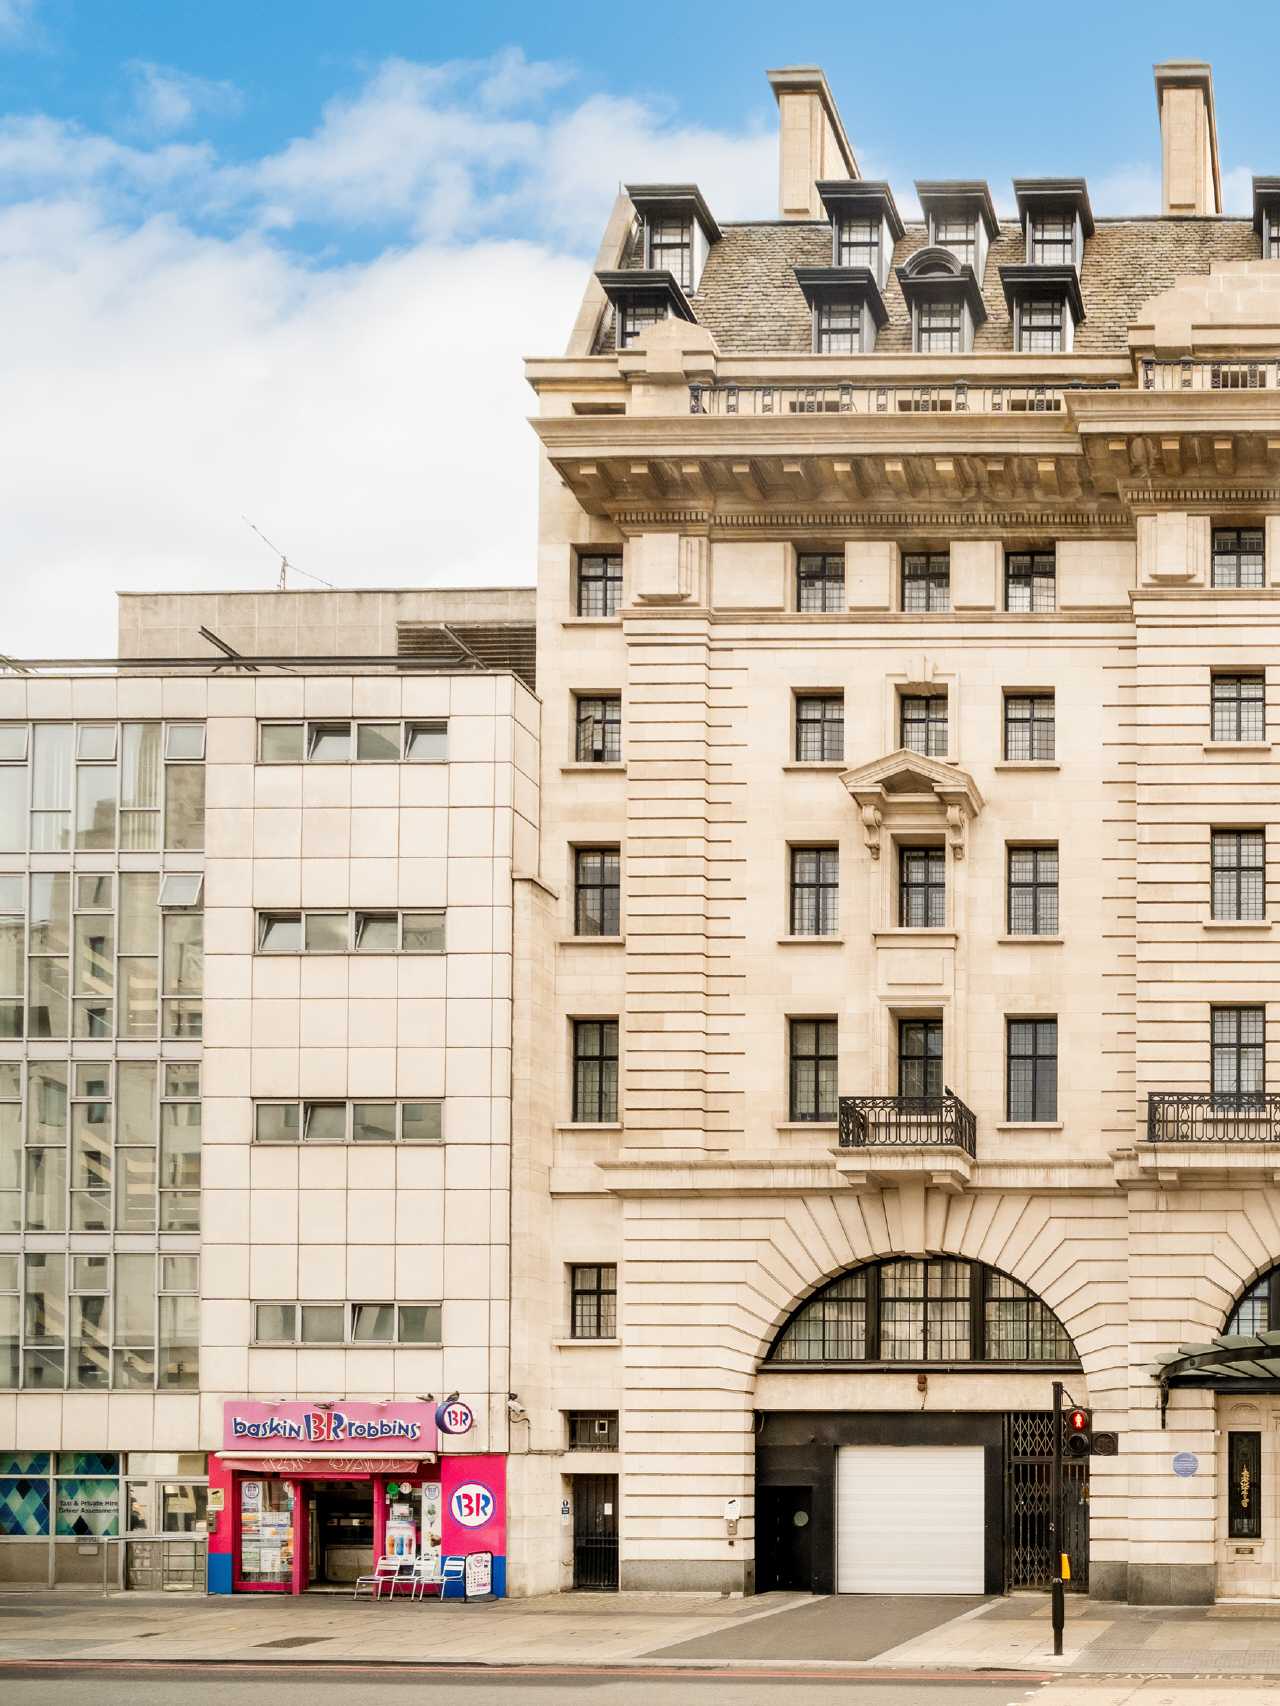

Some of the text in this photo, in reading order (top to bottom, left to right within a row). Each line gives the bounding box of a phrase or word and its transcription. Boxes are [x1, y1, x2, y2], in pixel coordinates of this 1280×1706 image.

[233, 1412, 421, 1441] baskin BR robbins
[447, 1410, 468, 1426] BR
[456, 1493, 491, 1517] BR
